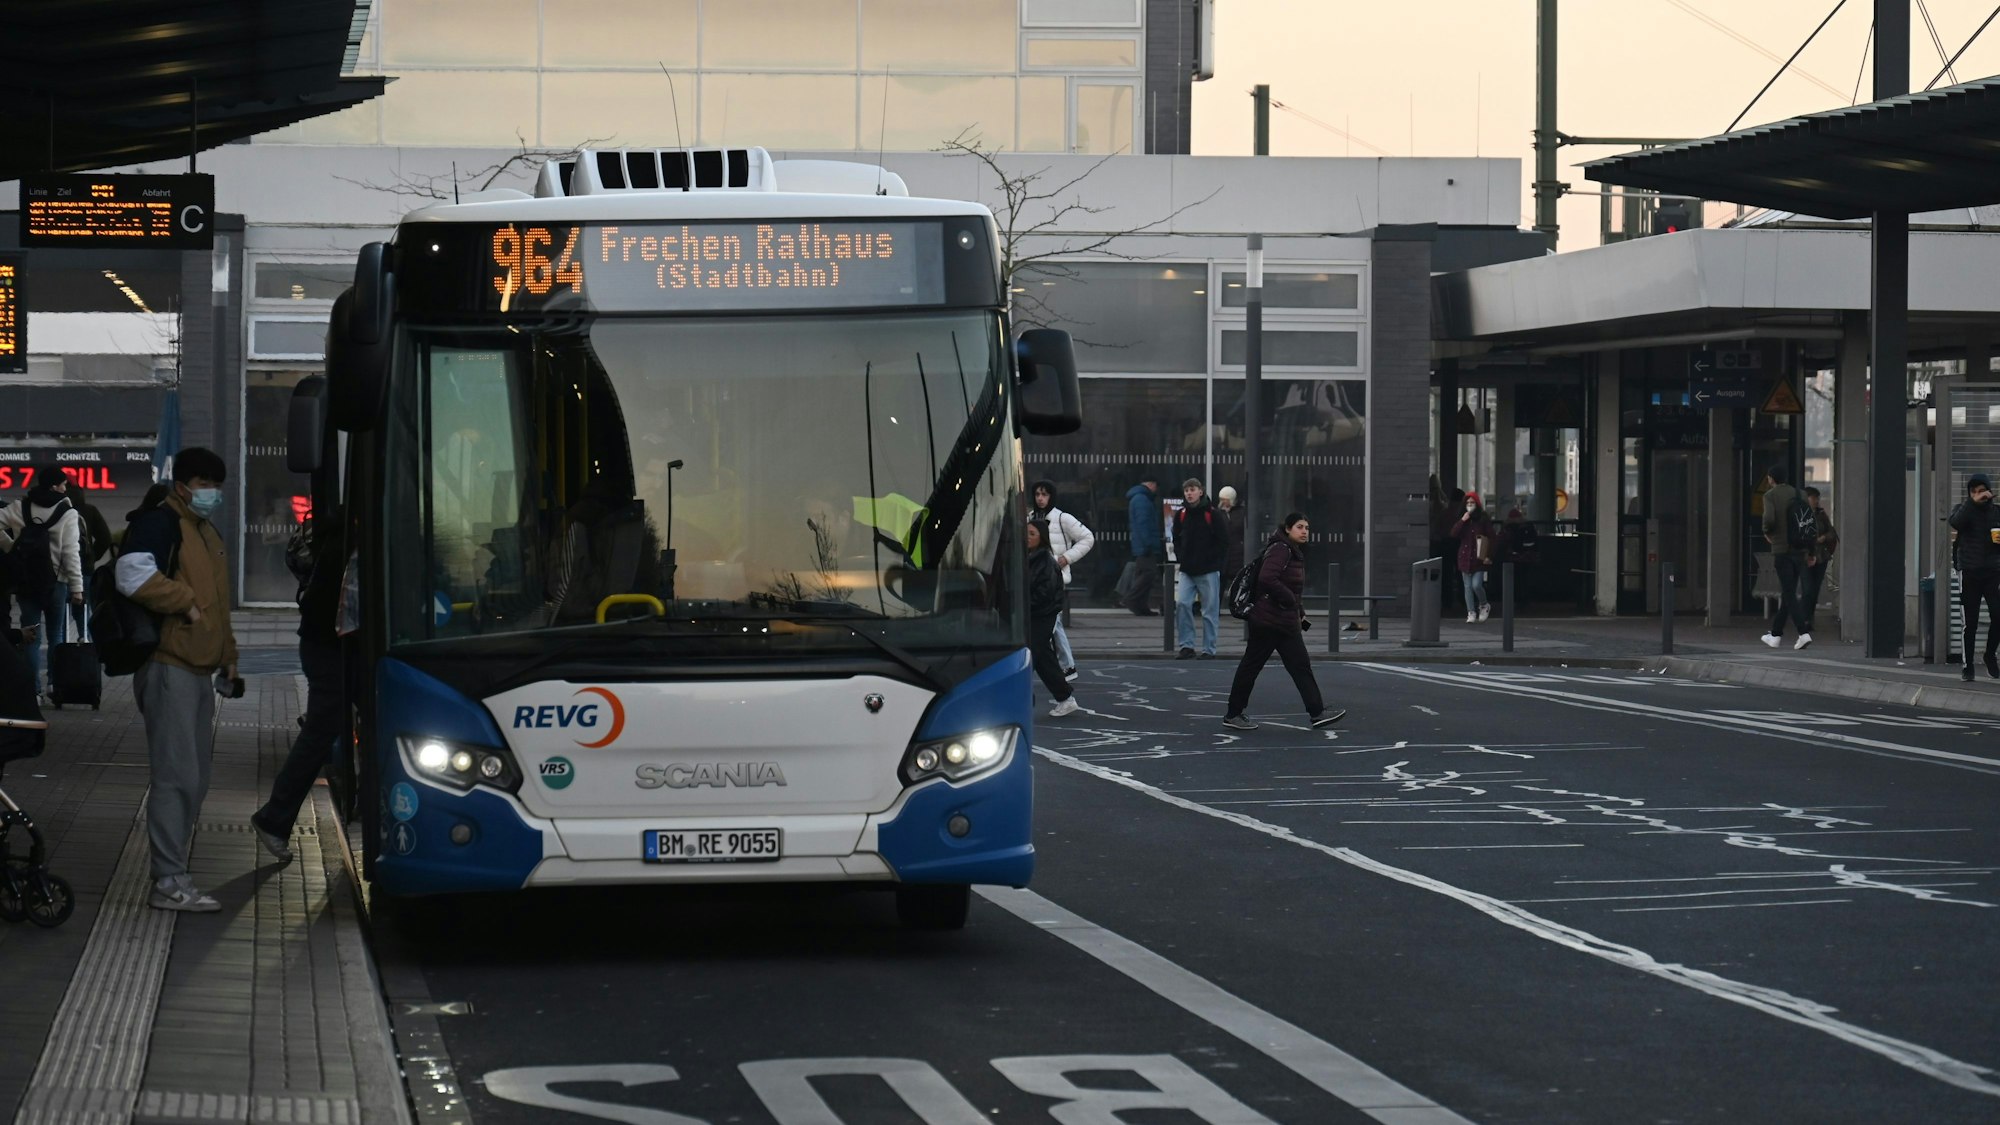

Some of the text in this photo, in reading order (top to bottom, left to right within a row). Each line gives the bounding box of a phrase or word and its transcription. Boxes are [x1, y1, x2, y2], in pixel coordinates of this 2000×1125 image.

[29, 188, 48, 196] Linie
[57, 188, 72, 196] Ziel
[142, 189, 171, 197] Abfahrt
[180, 205, 204, 233] C
[601, 224, 893, 262] Frechen Rathaus
[493, 227, 584, 294] 964
[656, 262, 840, 289] (Stadtbahn)
[1716, 389, 1745, 398] Ausgang
[56, 452, 101, 461] SCHNITZEL
[126, 452, 150, 461] PIZZA
[18, 467, 35, 489] 7
[513, 704, 599, 729] REVG
[539, 763, 566, 775] VRS
[635, 761, 788, 790] SCANIA
[658, 833, 776, 856] BM RE 9055
